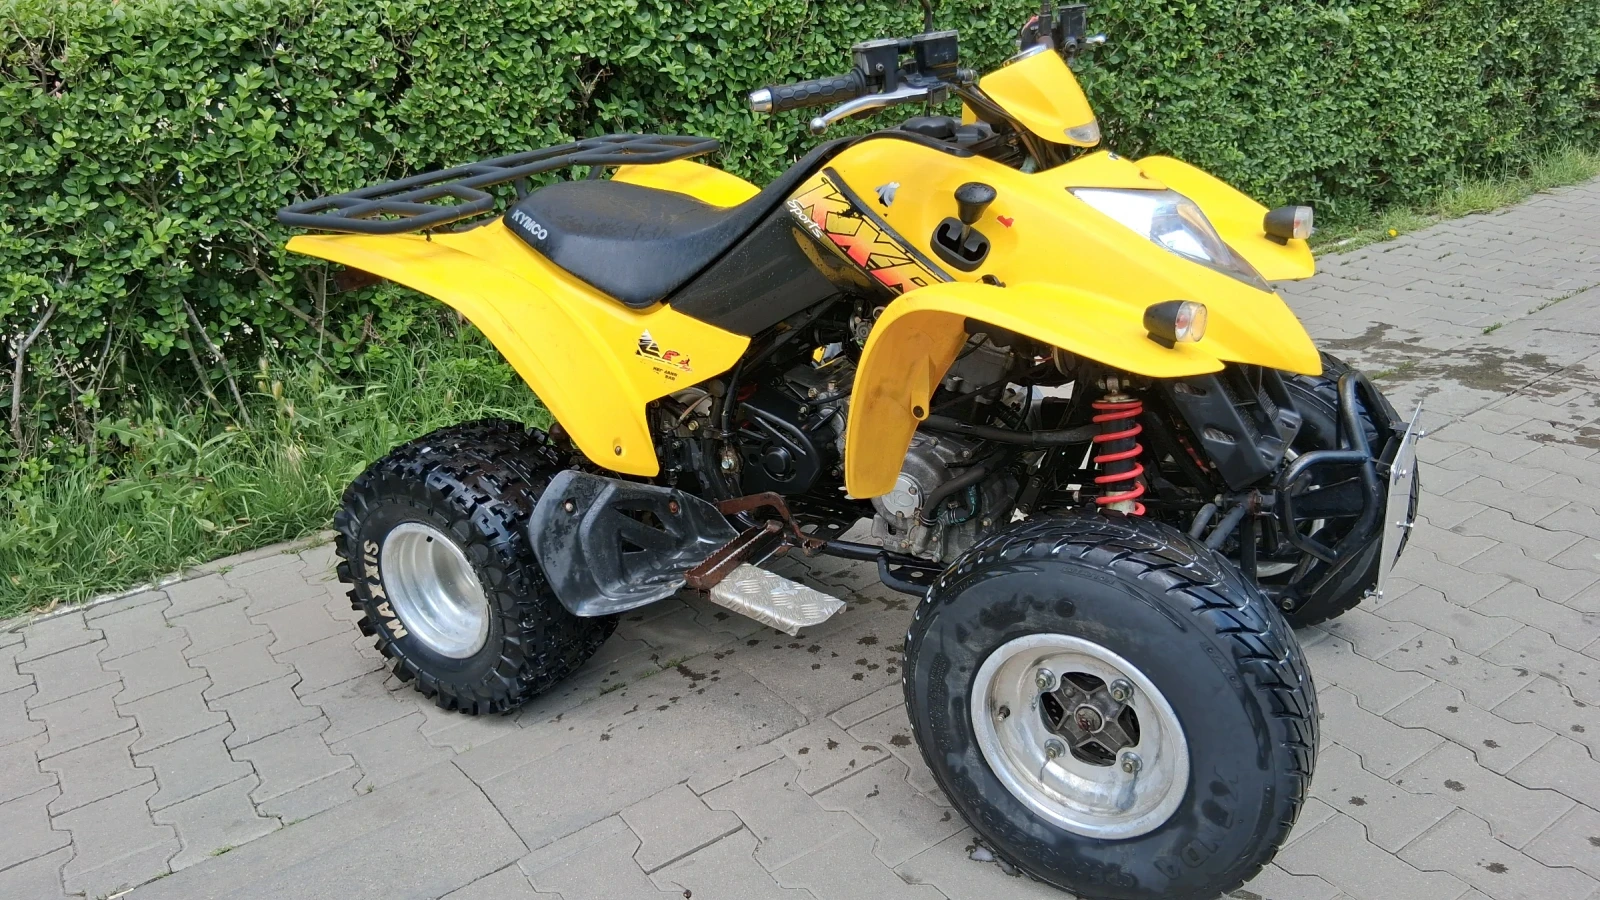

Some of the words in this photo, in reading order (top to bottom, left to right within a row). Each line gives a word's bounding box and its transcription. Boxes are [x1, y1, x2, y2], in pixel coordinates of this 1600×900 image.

[511, 209, 548, 240] KYMCO
[786, 198, 823, 239] Sports
[363, 539, 409, 640] MAXXIS
